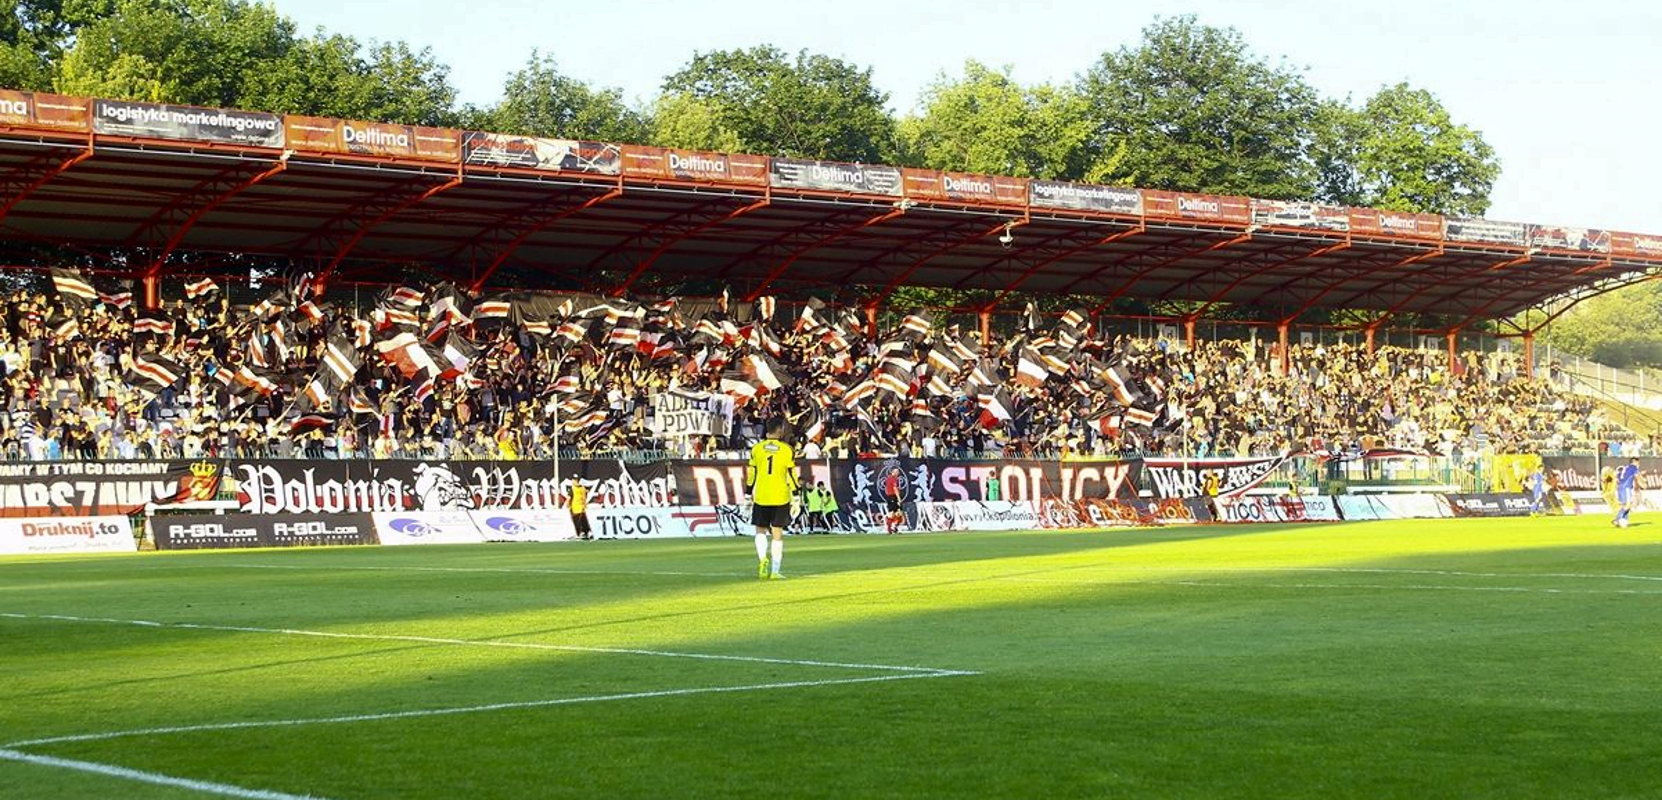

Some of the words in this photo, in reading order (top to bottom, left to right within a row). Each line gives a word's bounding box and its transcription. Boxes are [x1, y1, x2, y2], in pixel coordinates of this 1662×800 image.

[102, 103, 169, 123] logistyka
[173, 110, 276, 131] marketingowa
[342, 125, 408, 147] Deltima
[669, 153, 725, 173] Deltima
[943, 175, 991, 193] Deltima
[1034, 181, 1074, 197] logistyka
[1075, 188, 1138, 203] marketingowa
[0, 464, 33, 477] AMY
[53, 462, 83, 475] TYM
[86, 462, 103, 475] CO
[106, 462, 169, 475] KOCHAMY
[766, 454, 775, 475] 1
[0, 481, 178, 516] ARSZAWY
[238, 463, 405, 515] Polonia
[21, 521, 120, 539] Druknij.to
